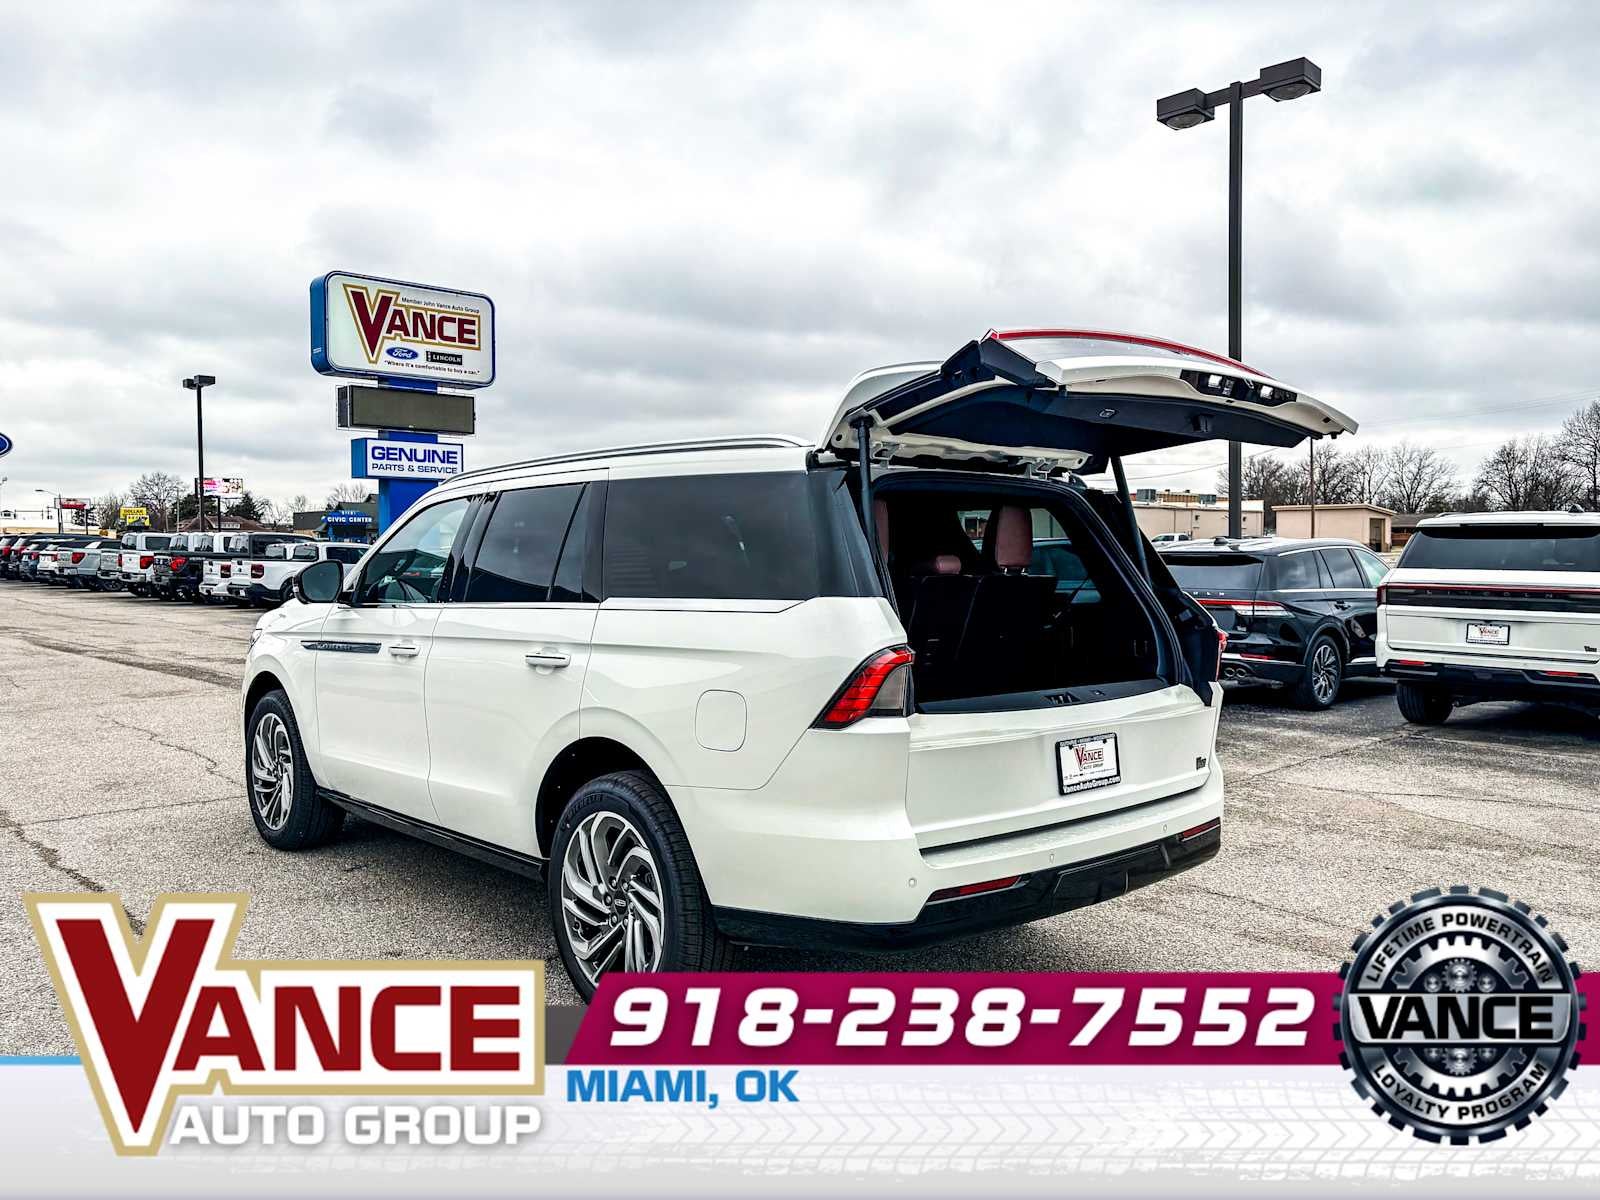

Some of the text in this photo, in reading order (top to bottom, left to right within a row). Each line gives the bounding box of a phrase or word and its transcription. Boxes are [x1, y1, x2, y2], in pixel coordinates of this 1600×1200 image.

[401, 296, 423, 305] Member
[436, 302, 451, 310] Vance
[451, 304, 463, 312] Auto
[464, 306, 480, 314] Group
[351, 290, 476, 357] VANCE
[392, 348, 413, 359] Ford
[432, 354, 461, 363] LINCOLN
[415, 363, 447, 372] comfortable
[371, 446, 458, 464] GENUINE
[372, 463, 405, 472] PARTS
[417, 465, 458, 474] SERVICE
[1075, 746, 1103, 767] VANCE
[1063, 776, 1121, 794] VanceAutoGroup.com
